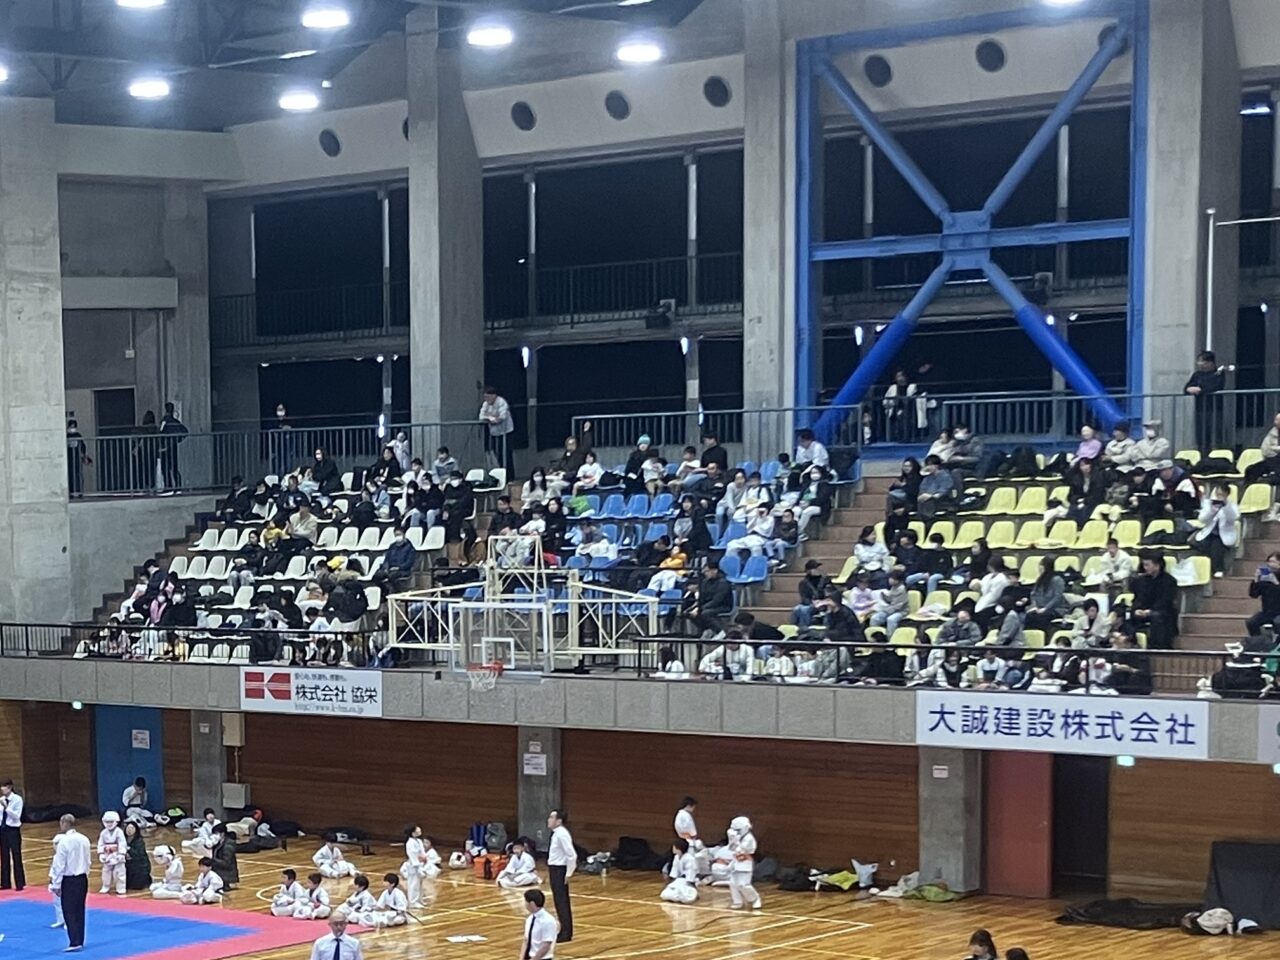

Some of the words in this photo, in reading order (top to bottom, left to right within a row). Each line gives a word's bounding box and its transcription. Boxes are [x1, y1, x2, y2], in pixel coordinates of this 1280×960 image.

[295, 684, 348, 703] 株式会社
[351, 686, 378, 704] 協栄
[927, 702, 1197, 746] 大誠建設株式会社
